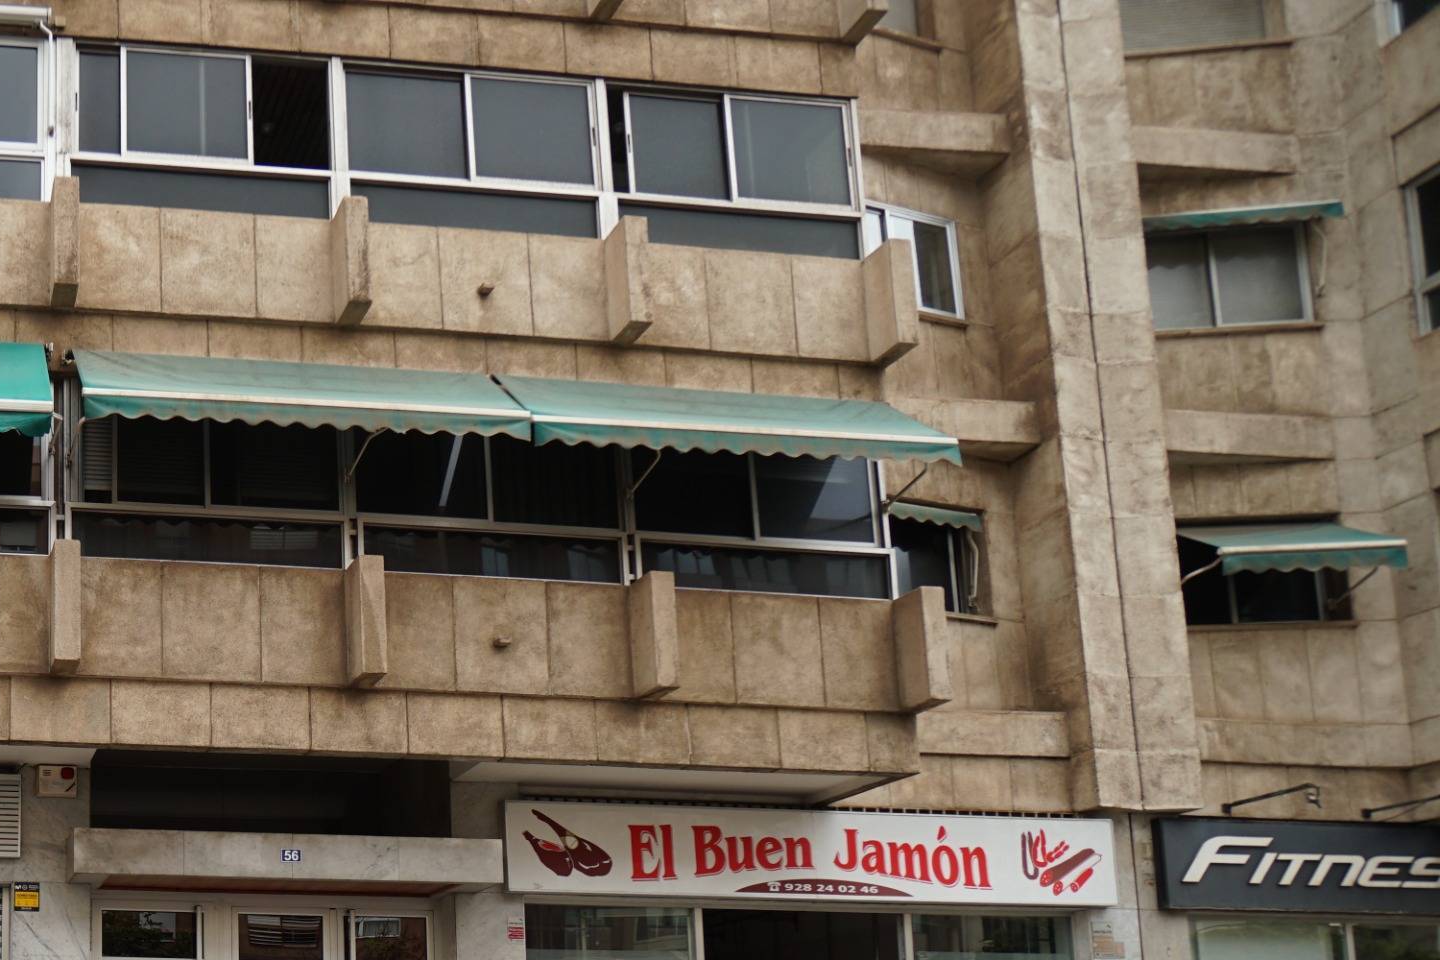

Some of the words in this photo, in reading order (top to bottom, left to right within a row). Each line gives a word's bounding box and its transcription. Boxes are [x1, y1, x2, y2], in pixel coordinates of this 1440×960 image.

[284, 850, 299, 861] 56
[628, 824, 678, 881] El
[691, 825, 815, 878] Buen
[833, 825, 993, 890] Jamón
[784, 883, 812, 892] 928
[816, 884, 834, 893] 24
[838, 884, 856, 893] 02
[860, 885, 878, 894] 46
